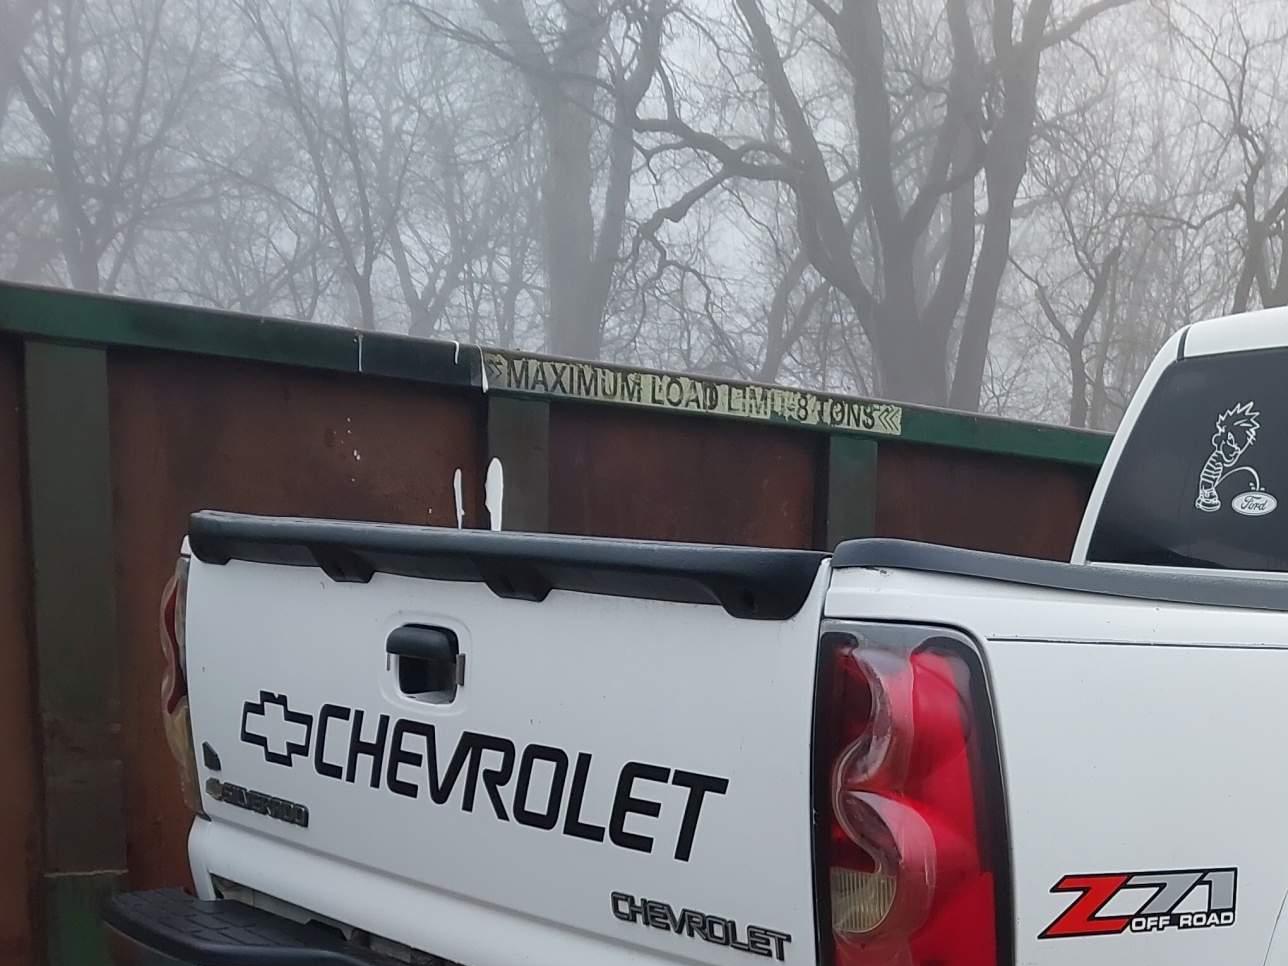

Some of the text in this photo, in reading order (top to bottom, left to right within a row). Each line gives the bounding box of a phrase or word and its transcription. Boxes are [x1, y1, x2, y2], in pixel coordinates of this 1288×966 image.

[506, 357, 642, 403] MAXIMUM
[651, 373, 719, 411] LOAD
[796, 395, 809, 421] 8
[815, 398, 876, 430] TONS
[1240, 495, 1269, 511] Ford
[313, 703, 730, 862] CHEVROLET
[611, 891, 792, 962] CHEVROLET
[1038, 867, 1238, 940] Z71
[1130, 911, 1235, 932] OFF ROAD
